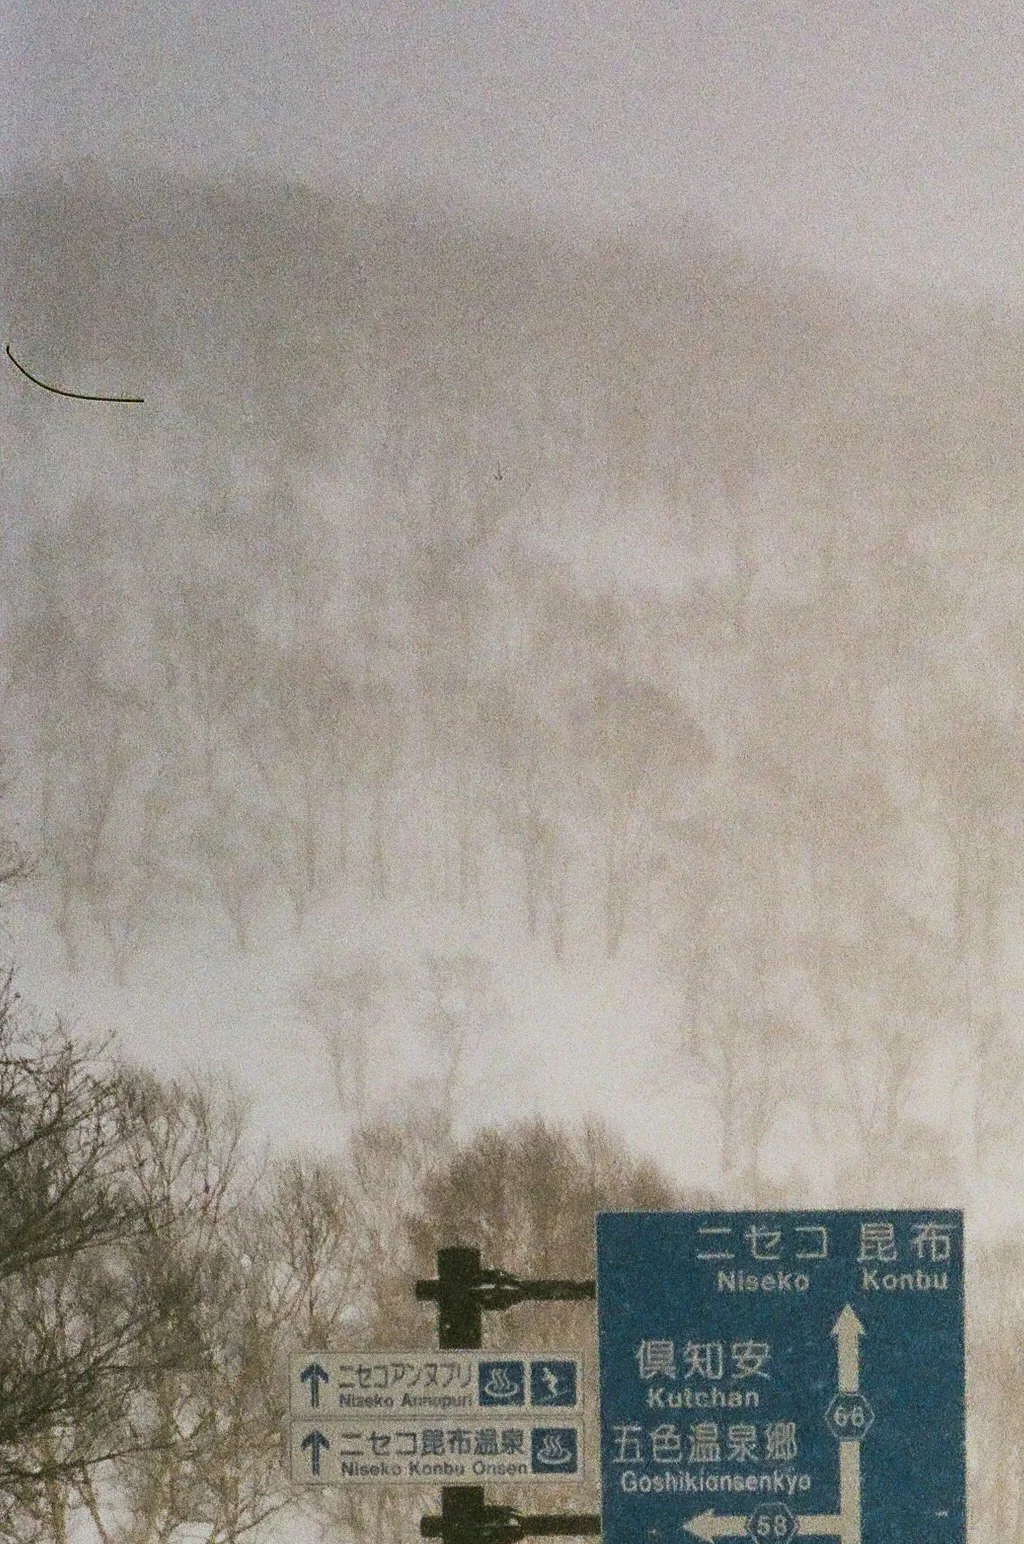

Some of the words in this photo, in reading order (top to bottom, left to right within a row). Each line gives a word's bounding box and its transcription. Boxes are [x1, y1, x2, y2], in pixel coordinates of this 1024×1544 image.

[697, 1223, 828, 1260] ニセコ
[857, 1222, 953, 1262] 昆布
[717, 1270, 811, 1292] Niseko
[862, 1270, 949, 1291] Konbu
[339, 1394, 395, 1408] Niseko
[648, 1388, 760, 1408] Kutchan
[340, 1428, 525, 1456] ニセコ昆布温泉
[613, 1421, 798, 1464] 五色温泉郷
[341, 1461, 401, 1476] Niseko
[409, 1461, 465, 1476] Konbu
[472, 1460, 528, 1476] Onsen
[620, 1470, 812, 1495] Goshikionsenkyo
